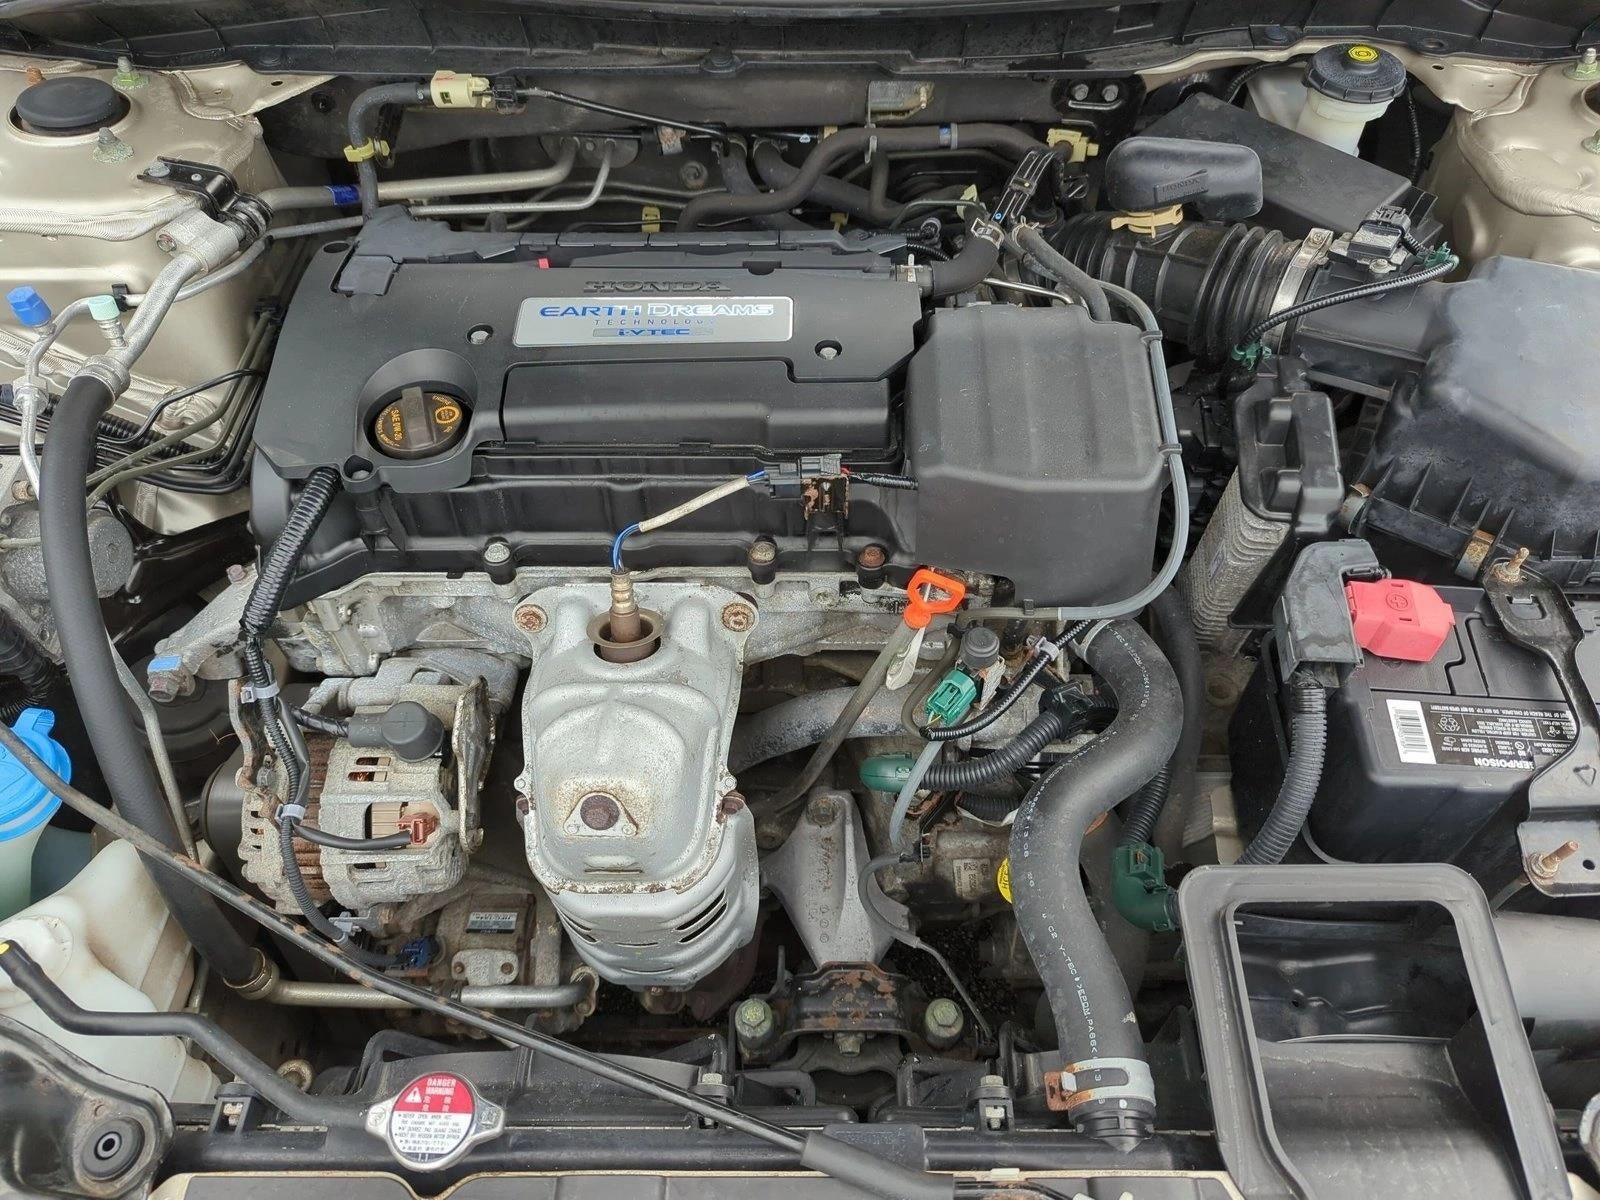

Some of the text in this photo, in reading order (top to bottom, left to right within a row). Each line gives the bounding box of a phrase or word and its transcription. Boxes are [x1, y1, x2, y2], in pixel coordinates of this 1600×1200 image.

[583, 280, 731, 293] HONDA
[540, 304, 642, 317] EARTH
[426, 1078, 456, 1088] DANGER
